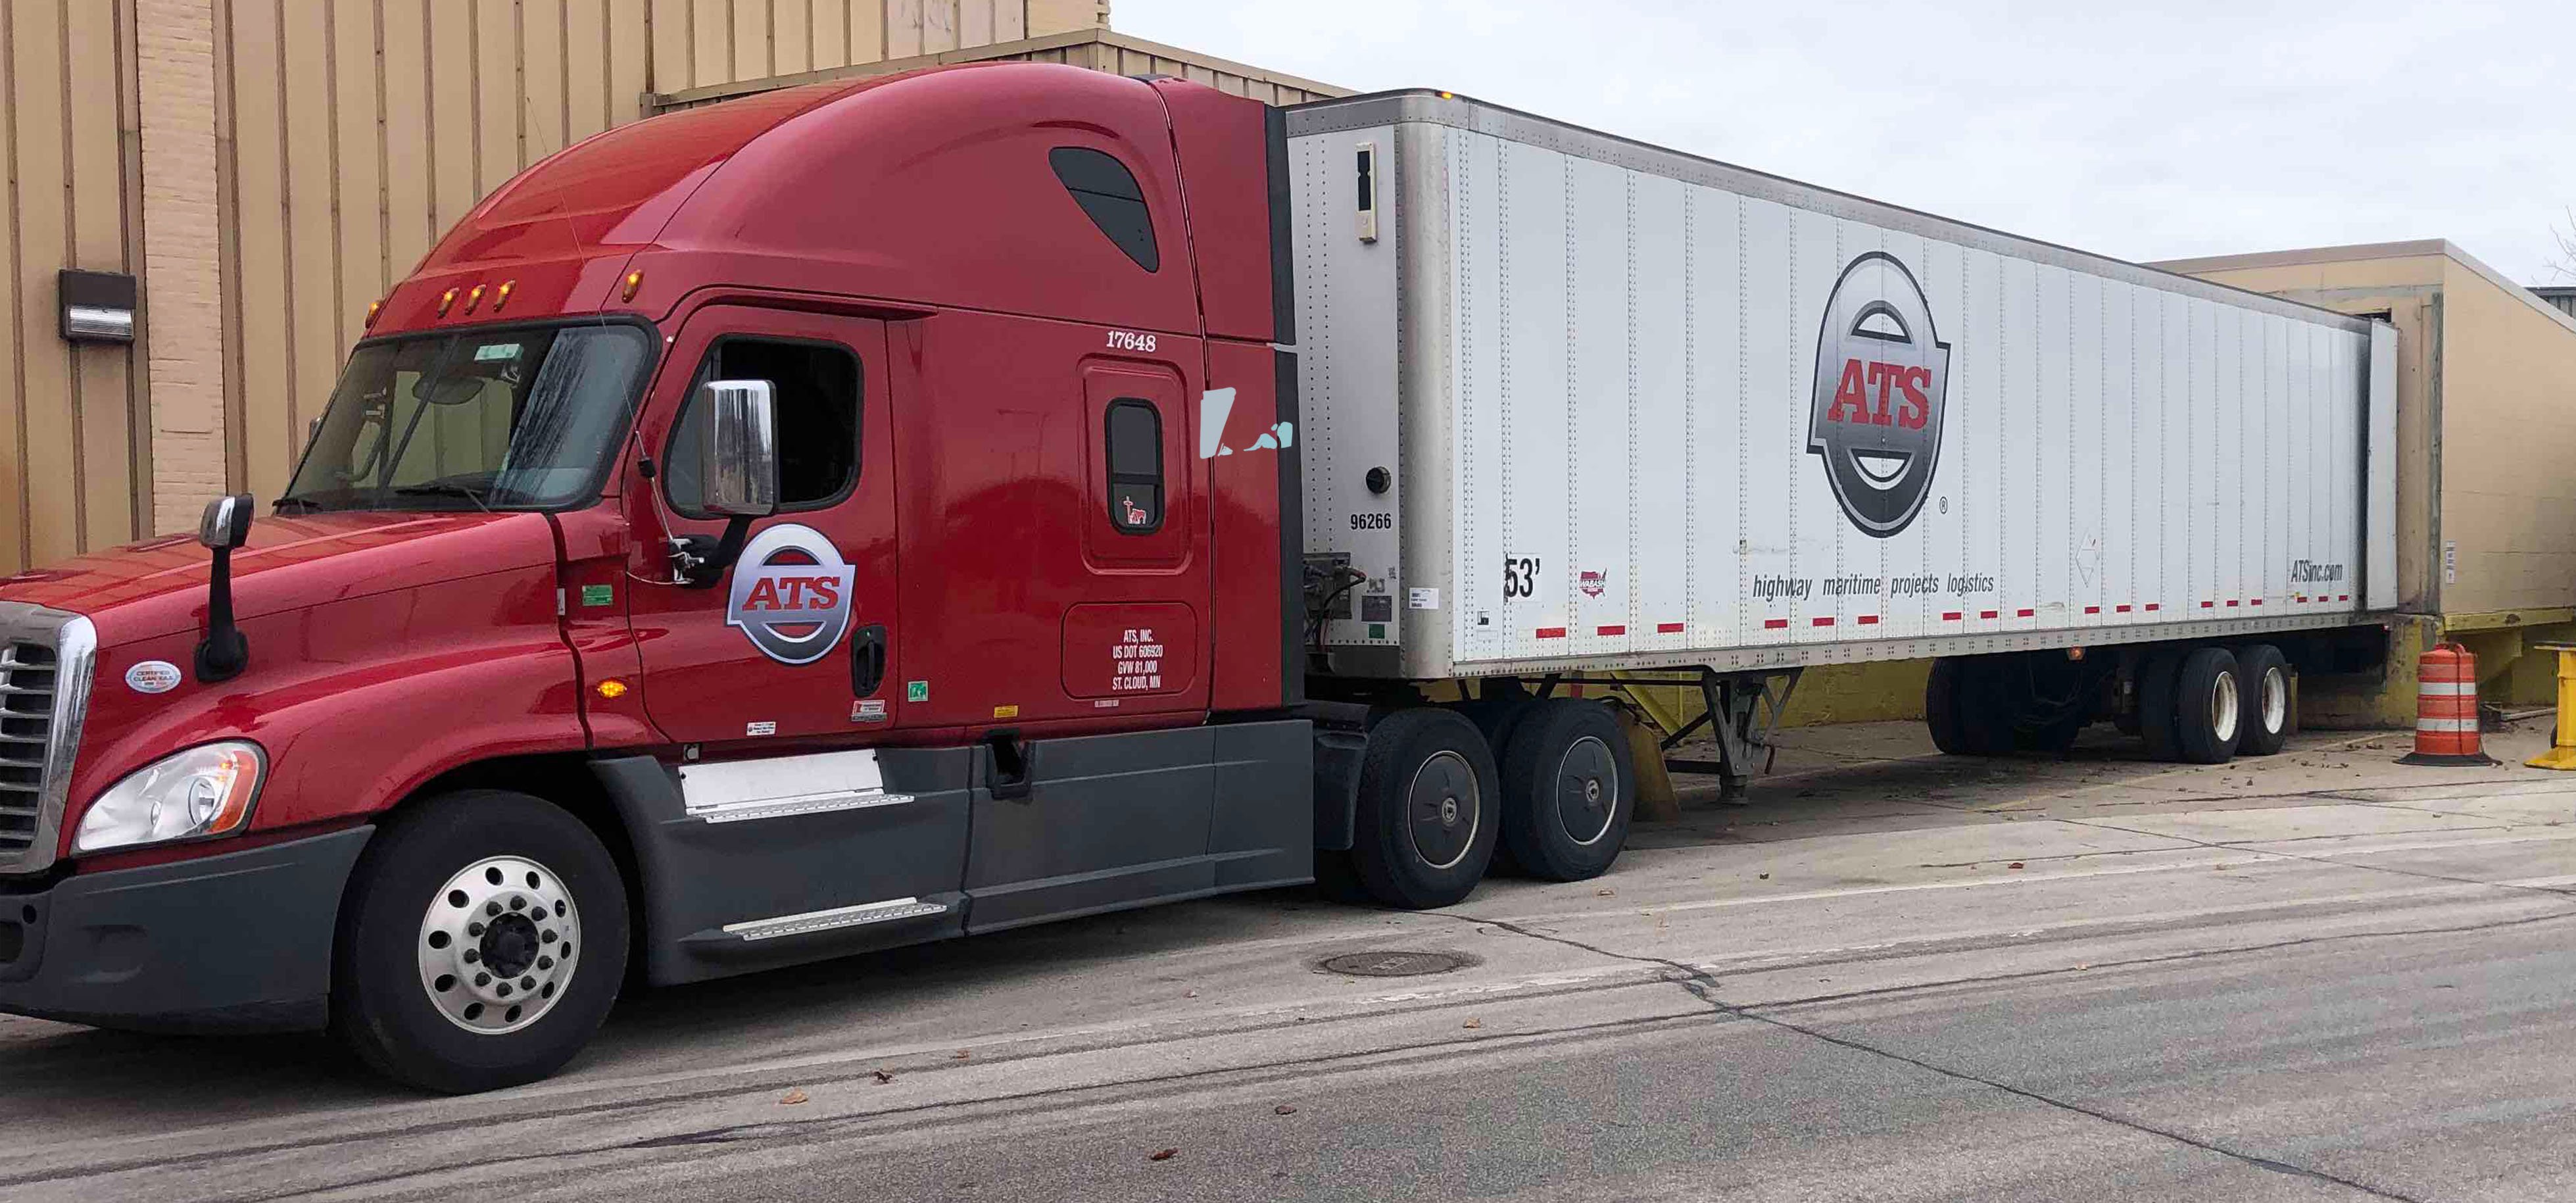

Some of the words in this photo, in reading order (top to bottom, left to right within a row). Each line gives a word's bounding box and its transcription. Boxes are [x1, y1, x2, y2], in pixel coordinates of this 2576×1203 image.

[1106, 331, 1156, 352] 17648
[1826, 358, 1932, 430] ATS
[1350, 513, 1392, 530] 96266
[2291, 559, 2343, 583] ATSinc.com
[742, 576, 840, 611] ATS
[1753, 574, 1812, 602] highway
[1822, 573, 1882, 595] maritime
[1891, 573, 1939, 599] projects
[1947, 572, 1994, 597] logistics
[1123, 629, 1138, 645] ATS,
[1140, 629, 1154, 643] INC.
[1113, 645, 1123, 659] US
[1124, 645, 1138, 658] DOT
[1118, 660, 1134, 674] GVW
[1135, 660, 1157, 675] 81,000
[1112, 677, 1123, 691] ST.
[1124, 675, 1148, 691] CLOUD,
[1150, 675, 1161, 689] MN
